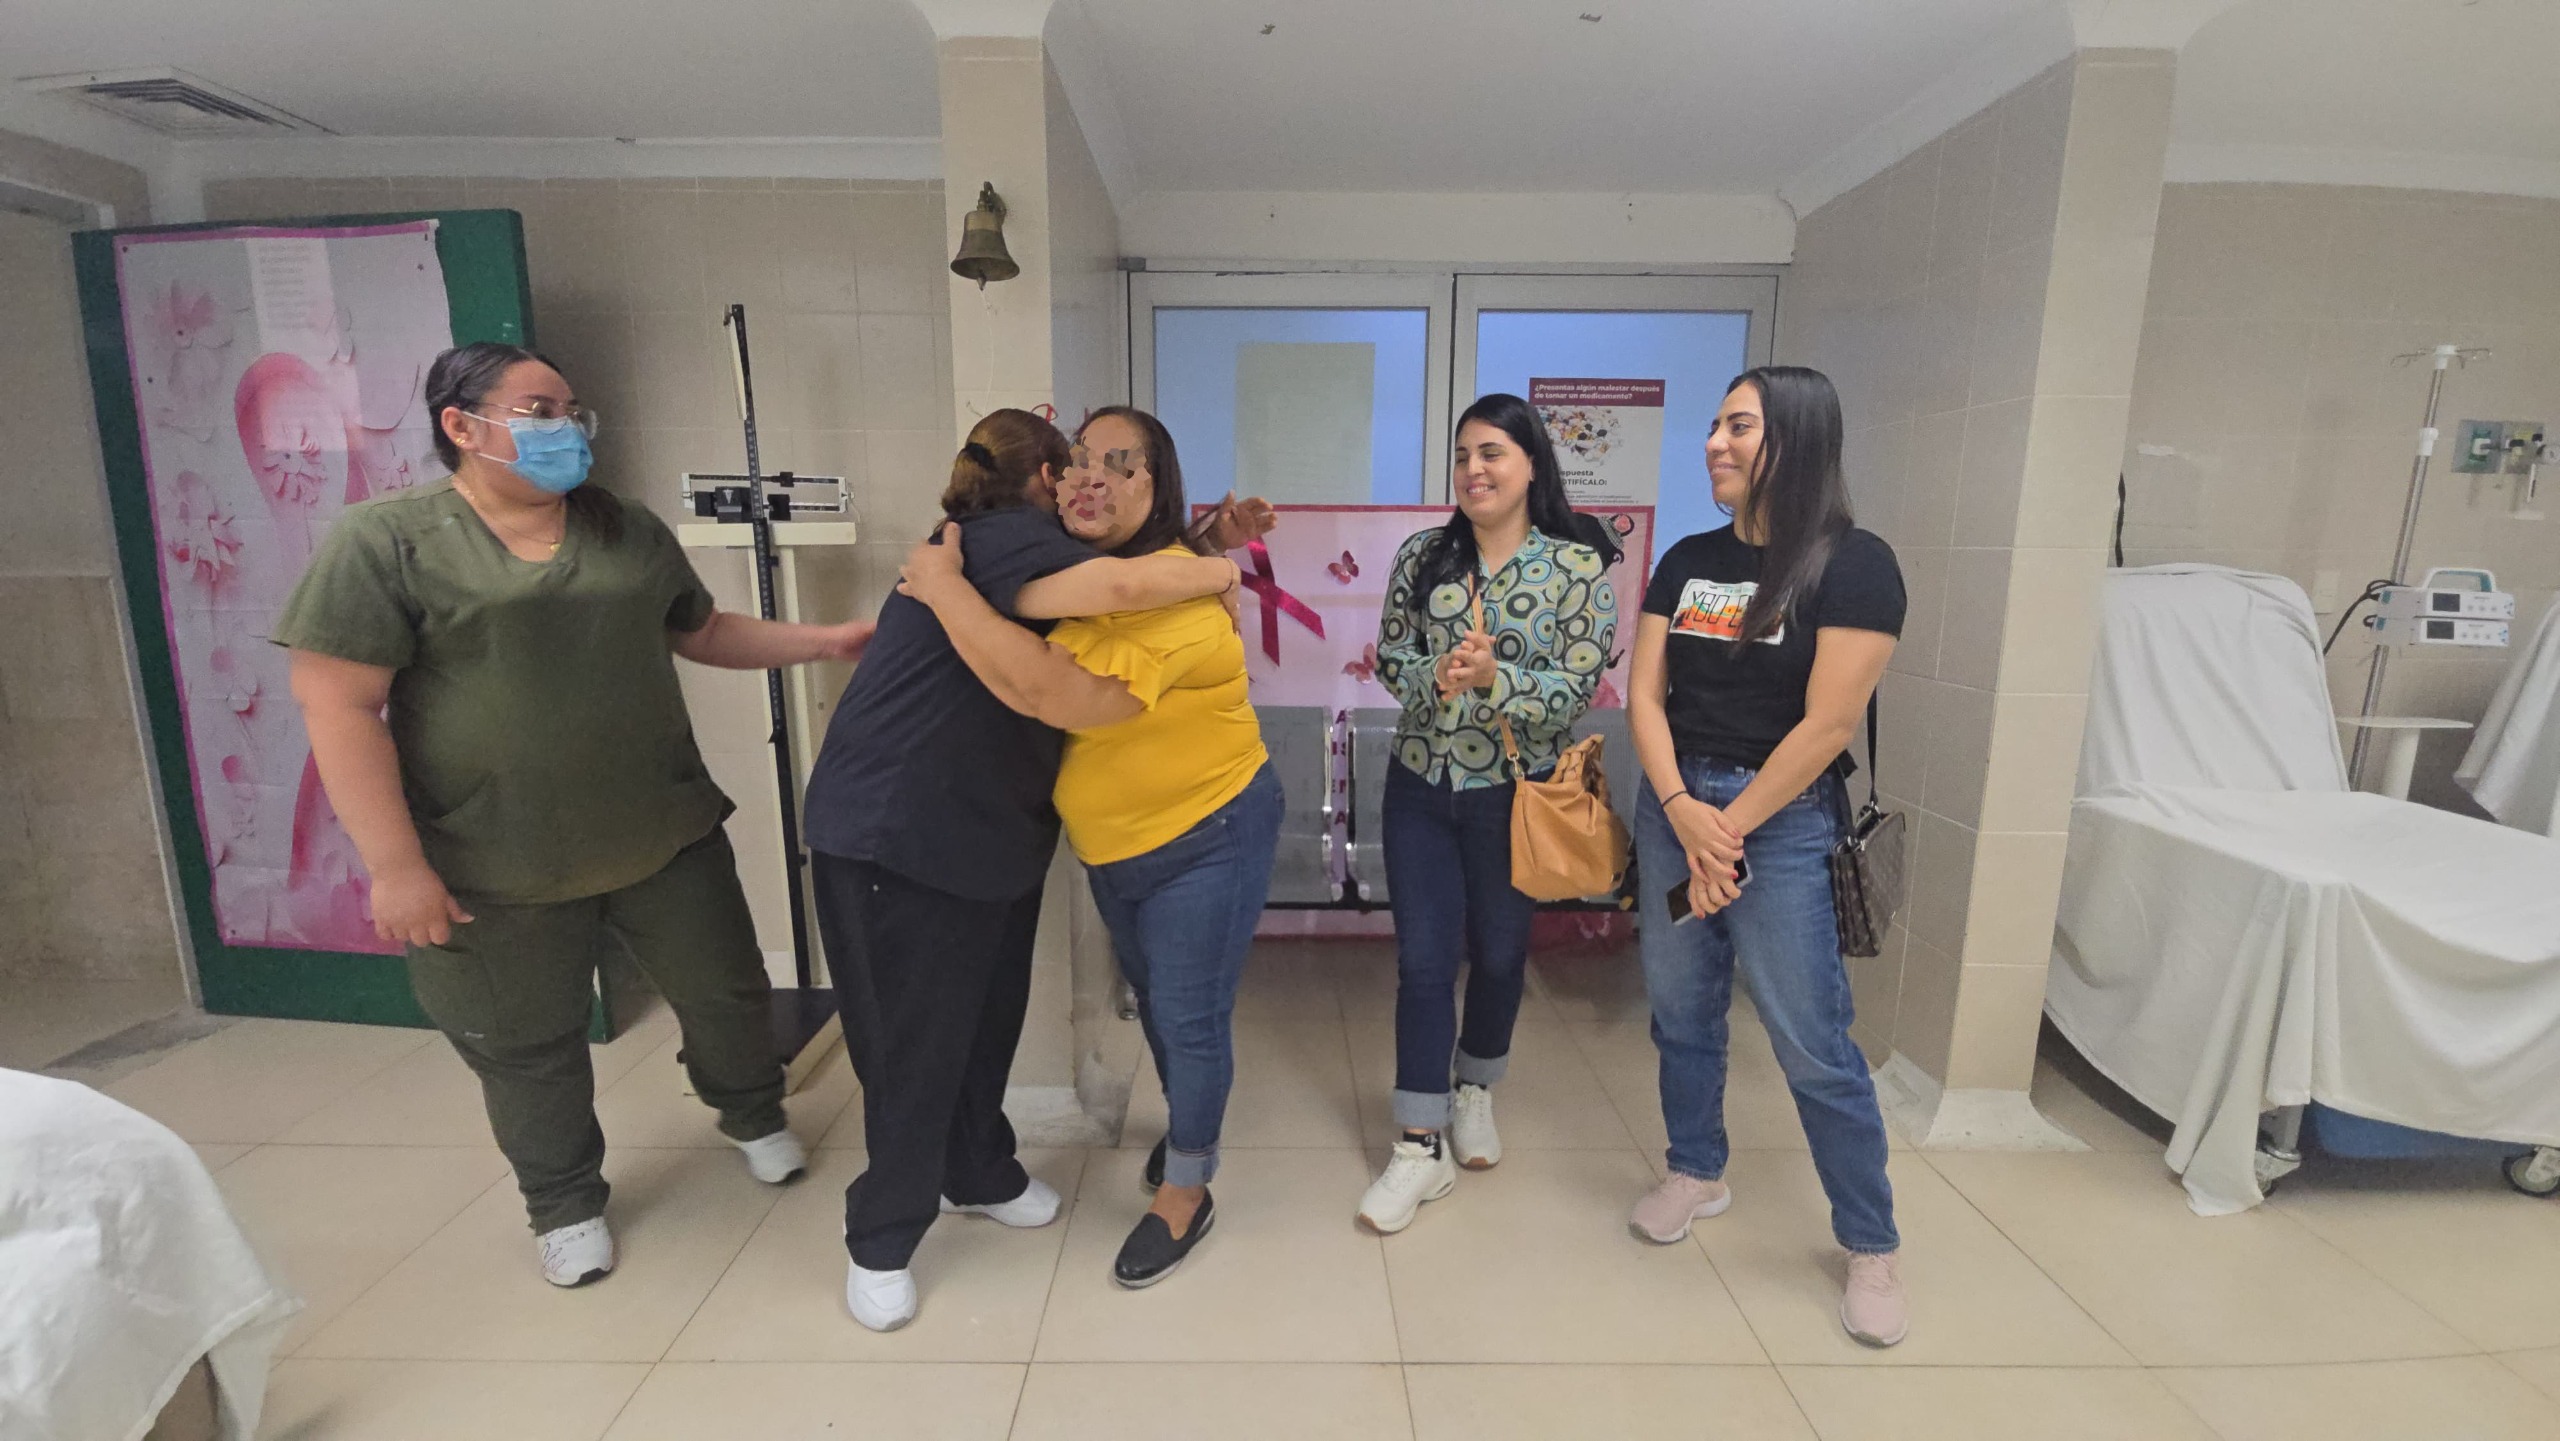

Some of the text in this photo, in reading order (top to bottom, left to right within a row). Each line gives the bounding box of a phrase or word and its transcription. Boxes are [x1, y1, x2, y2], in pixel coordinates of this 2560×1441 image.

[1576, 384, 1597, 392] algún
[1630, 385, 1660, 393] después
[1561, 478, 1607, 486] OTIFÍCALO:
